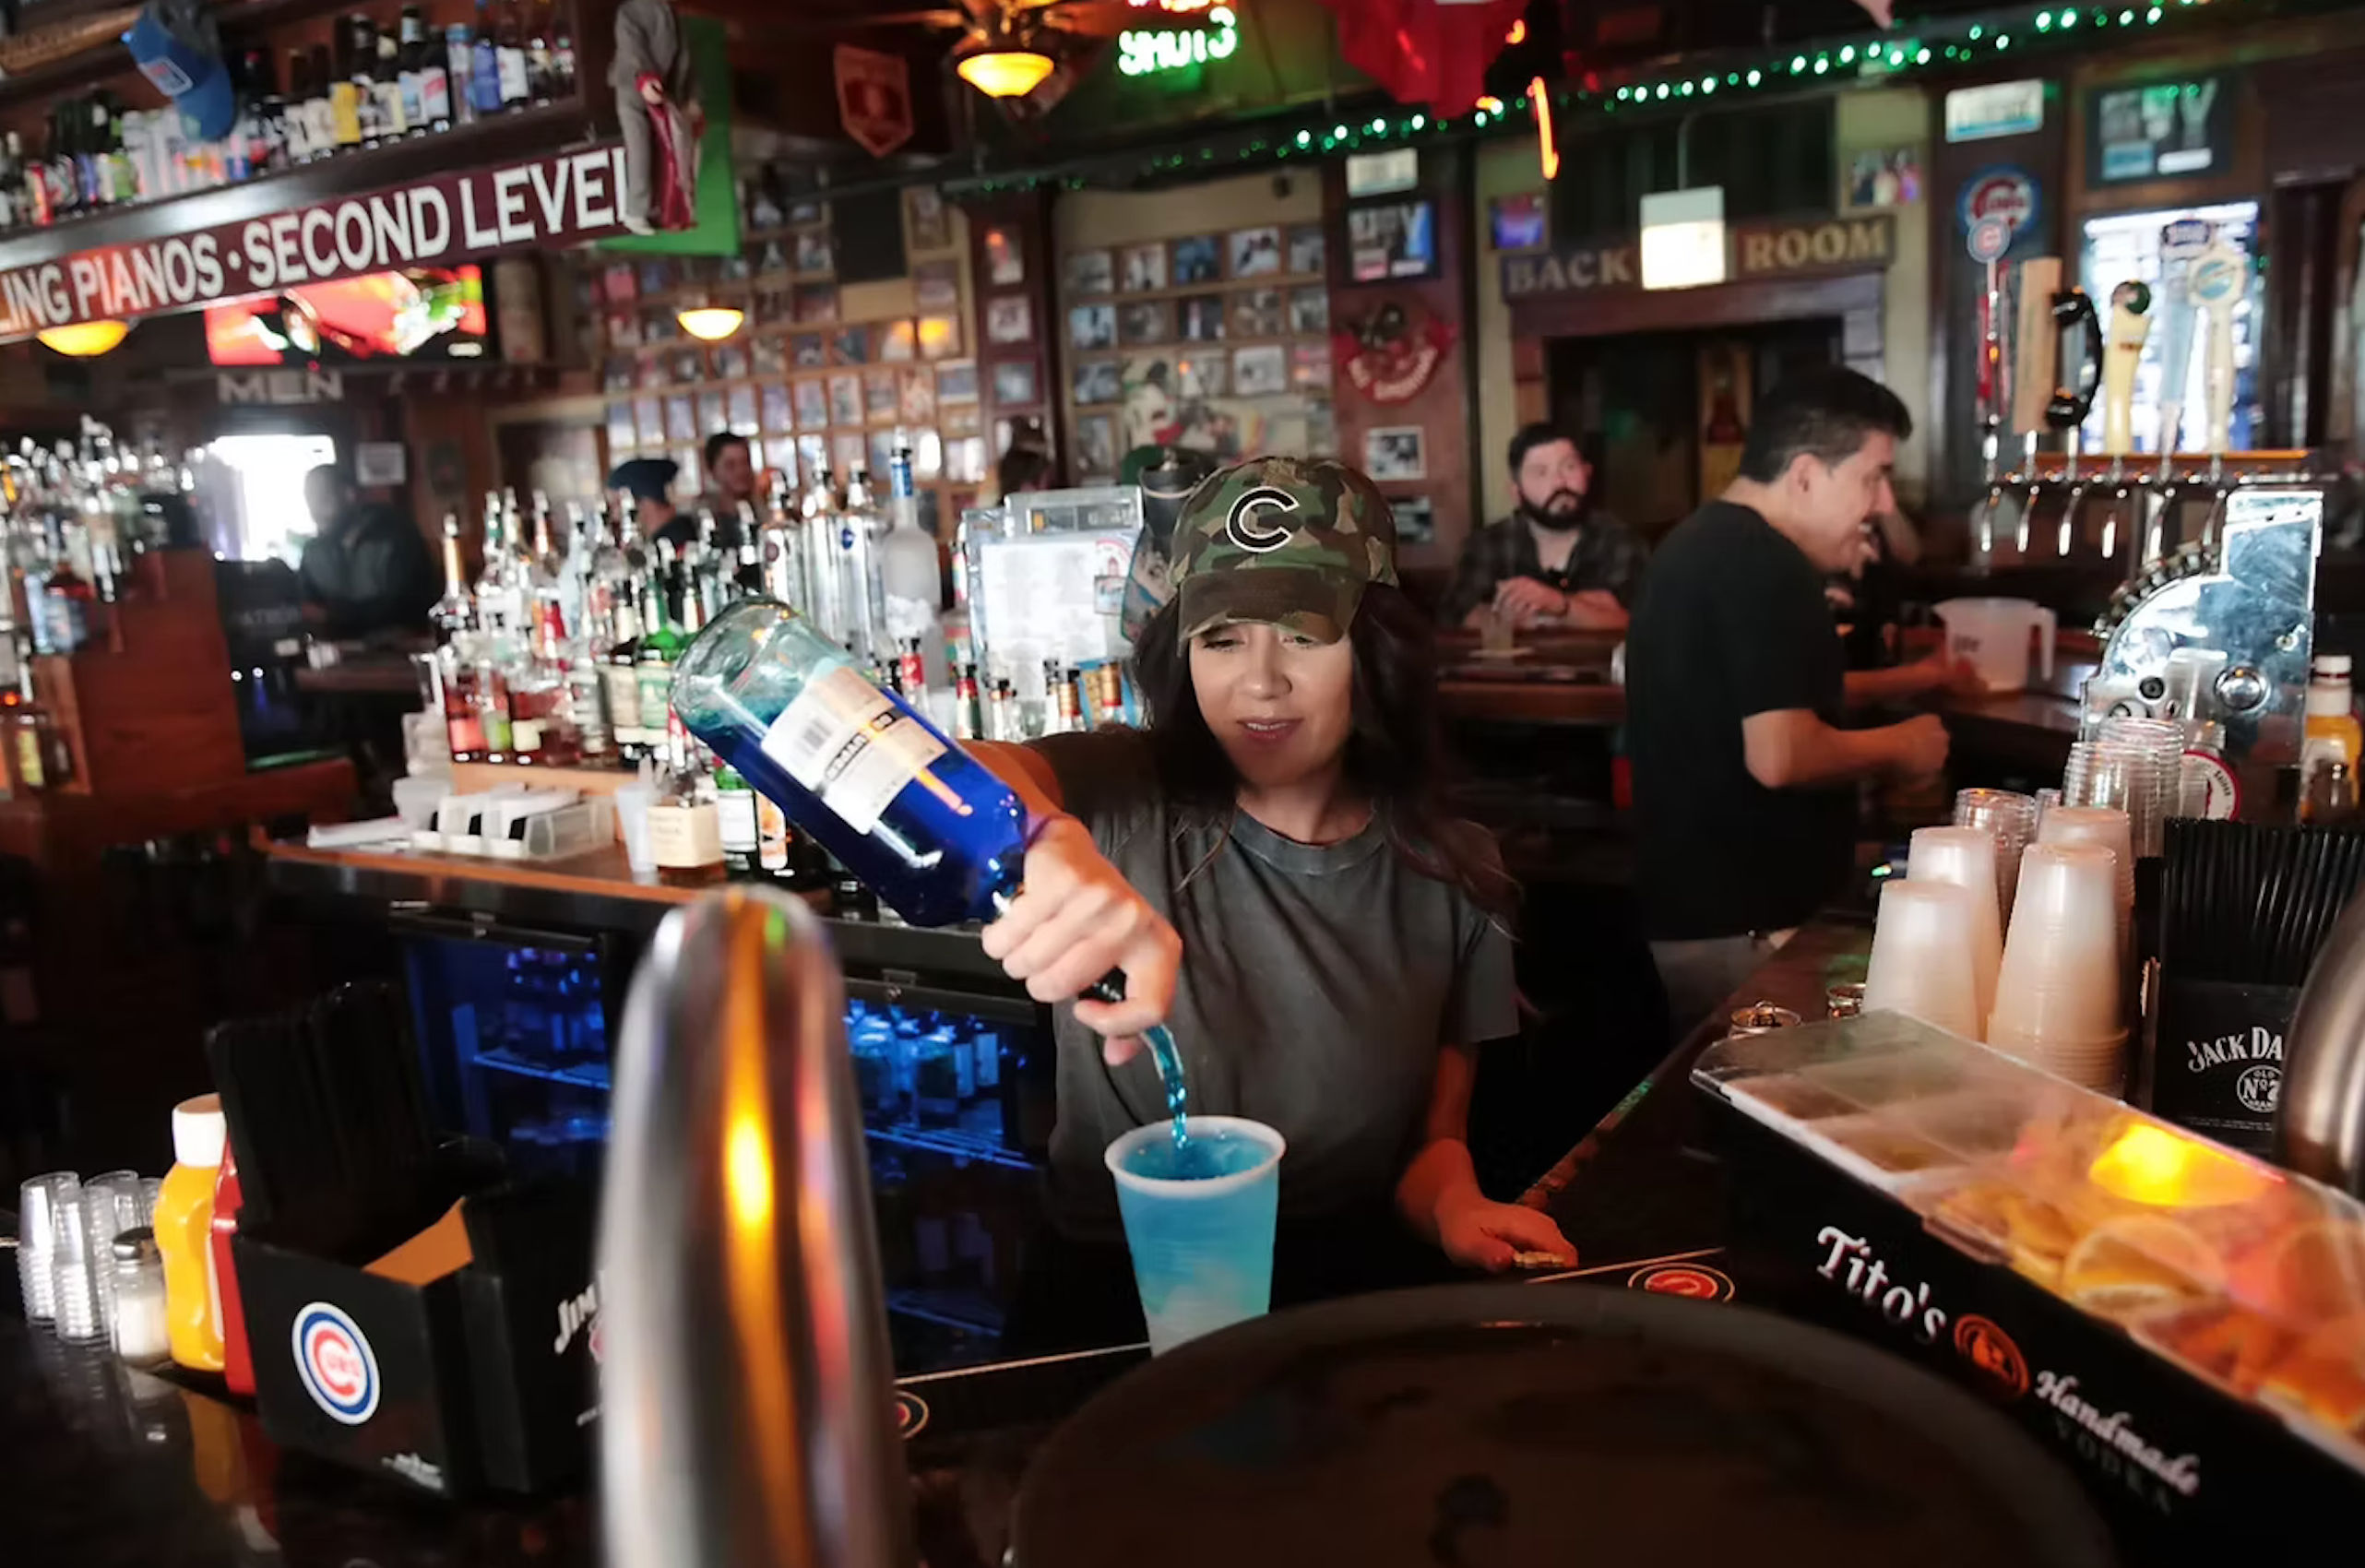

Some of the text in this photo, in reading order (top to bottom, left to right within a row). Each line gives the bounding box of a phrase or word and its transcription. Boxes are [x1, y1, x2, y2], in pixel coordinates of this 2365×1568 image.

[69, 232, 224, 319] PIANOS
[243, 185, 450, 289] SECOND
[1506, 219, 1887, 294] BACK ROOM
[217, 370, 345, 405] MEN
[1226, 486, 1300, 552] C
[2187, 1033, 2249, 1073] JACK
[1816, 1225, 1947, 1345] Tito's
[2034, 1370, 2201, 1496] Handmade
